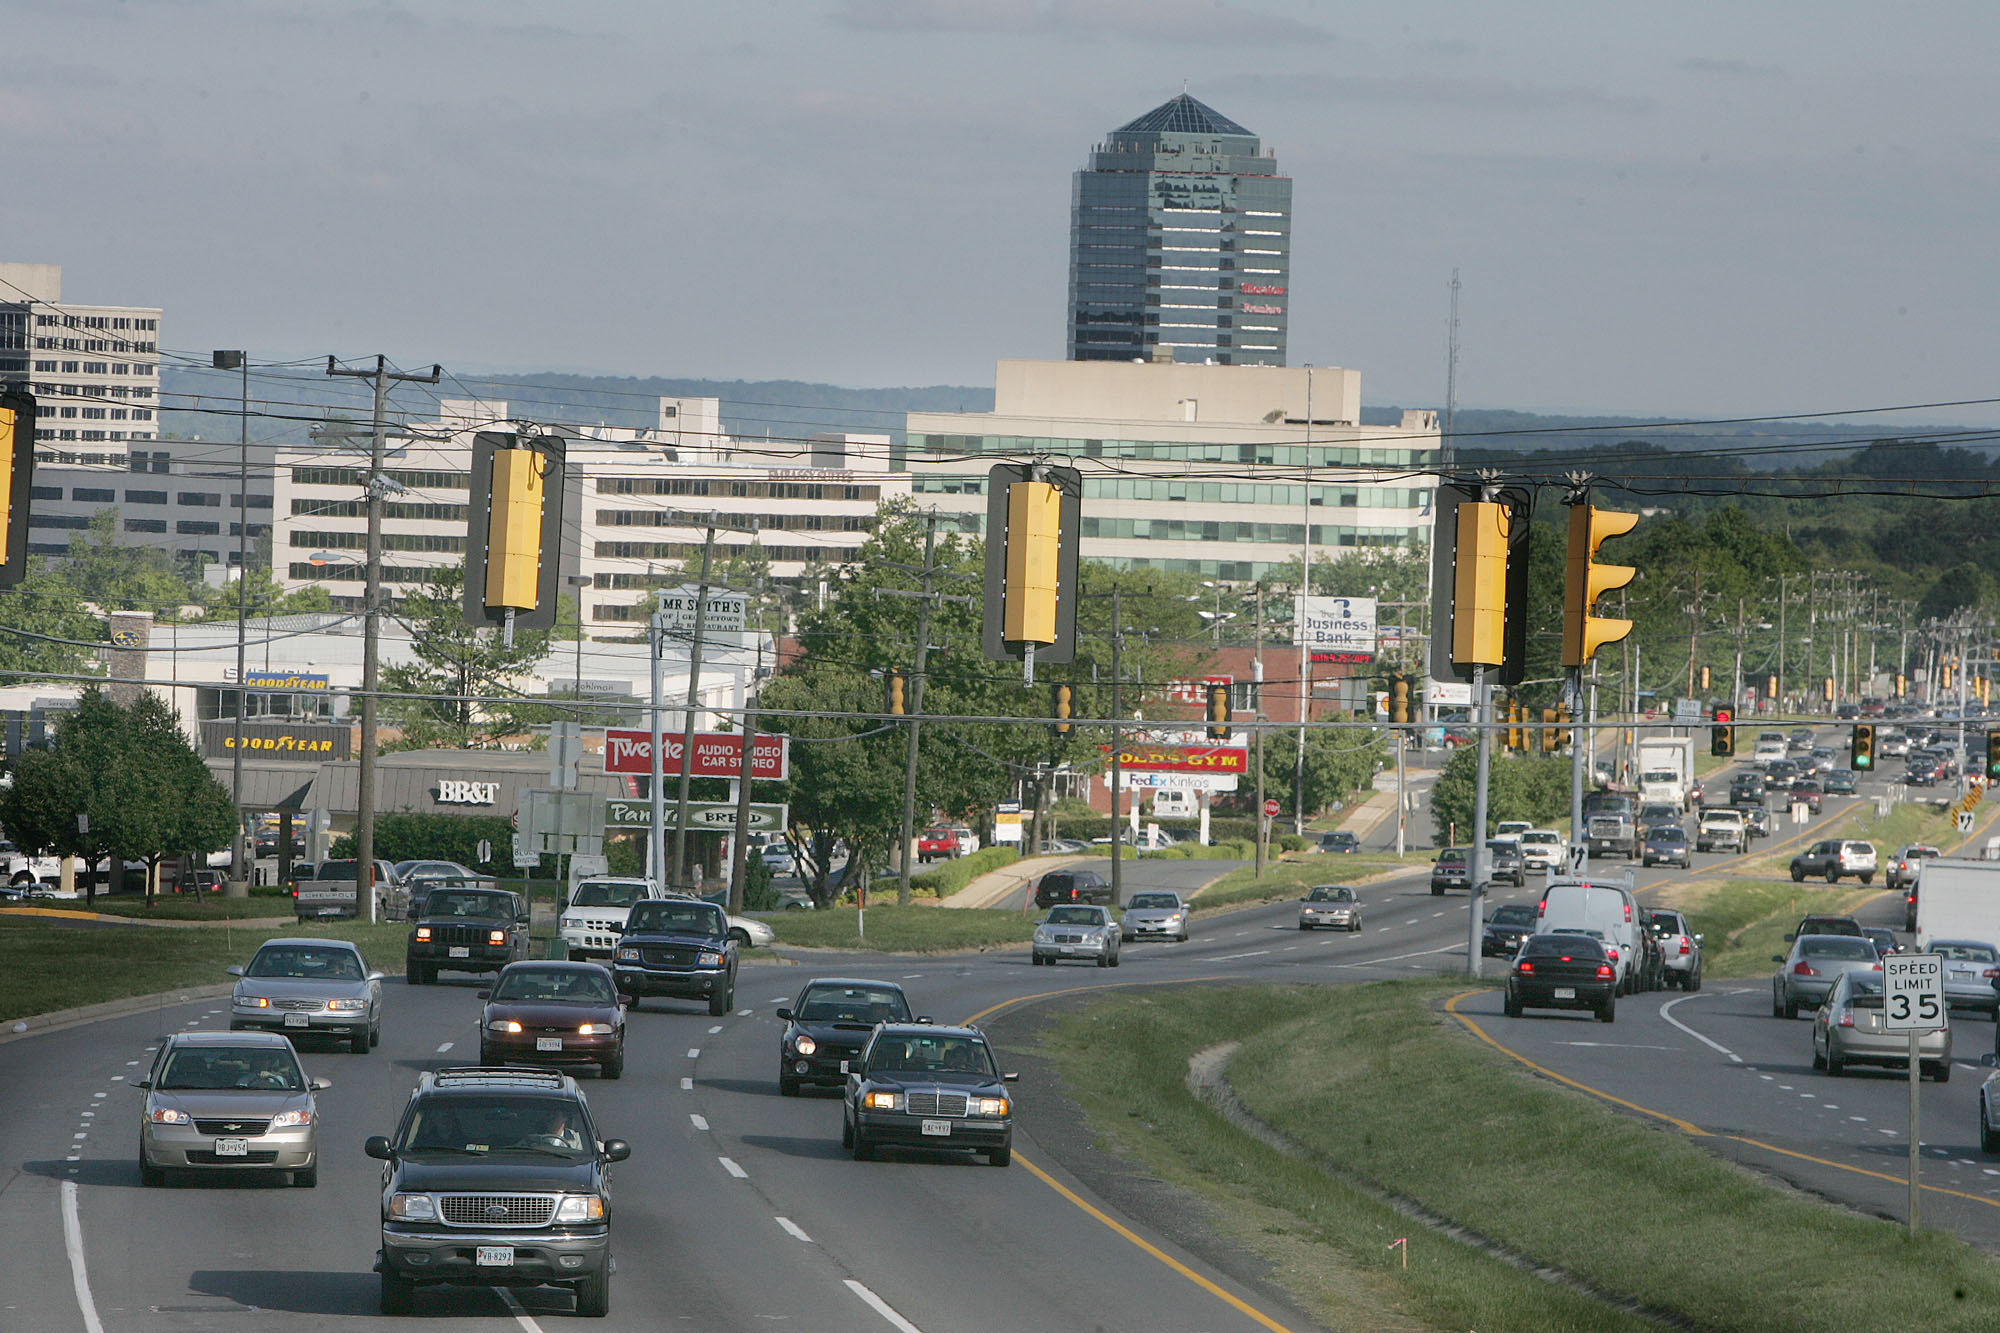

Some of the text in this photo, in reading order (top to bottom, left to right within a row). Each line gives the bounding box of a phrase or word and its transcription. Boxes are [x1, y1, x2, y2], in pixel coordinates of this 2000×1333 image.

[688, 600, 740, 613] SITH'S
[682, 614, 739, 622] GEOGETOWN
[687, 622, 739, 631] RETAURANT
[1317, 631, 1351, 644] Bank
[247, 676, 327, 689] GOODYEAR
[224, 736, 333, 751] GOODYEAR
[697, 744, 734, 755] AUDIO
[747, 746, 781, 757] IDEO
[702, 756, 775, 769] CAR STREO
[1187, 754, 1239, 767] GYM
[1130, 774, 1210, 789] FedEx Kinko's
[438, 780, 500, 803] BB&T
[705, 812, 762, 824] BRED
[1889, 963, 1938, 975] SPEED
[1894, 978, 1932, 990] LIMIT
[1890, 994, 1940, 1020] 35
